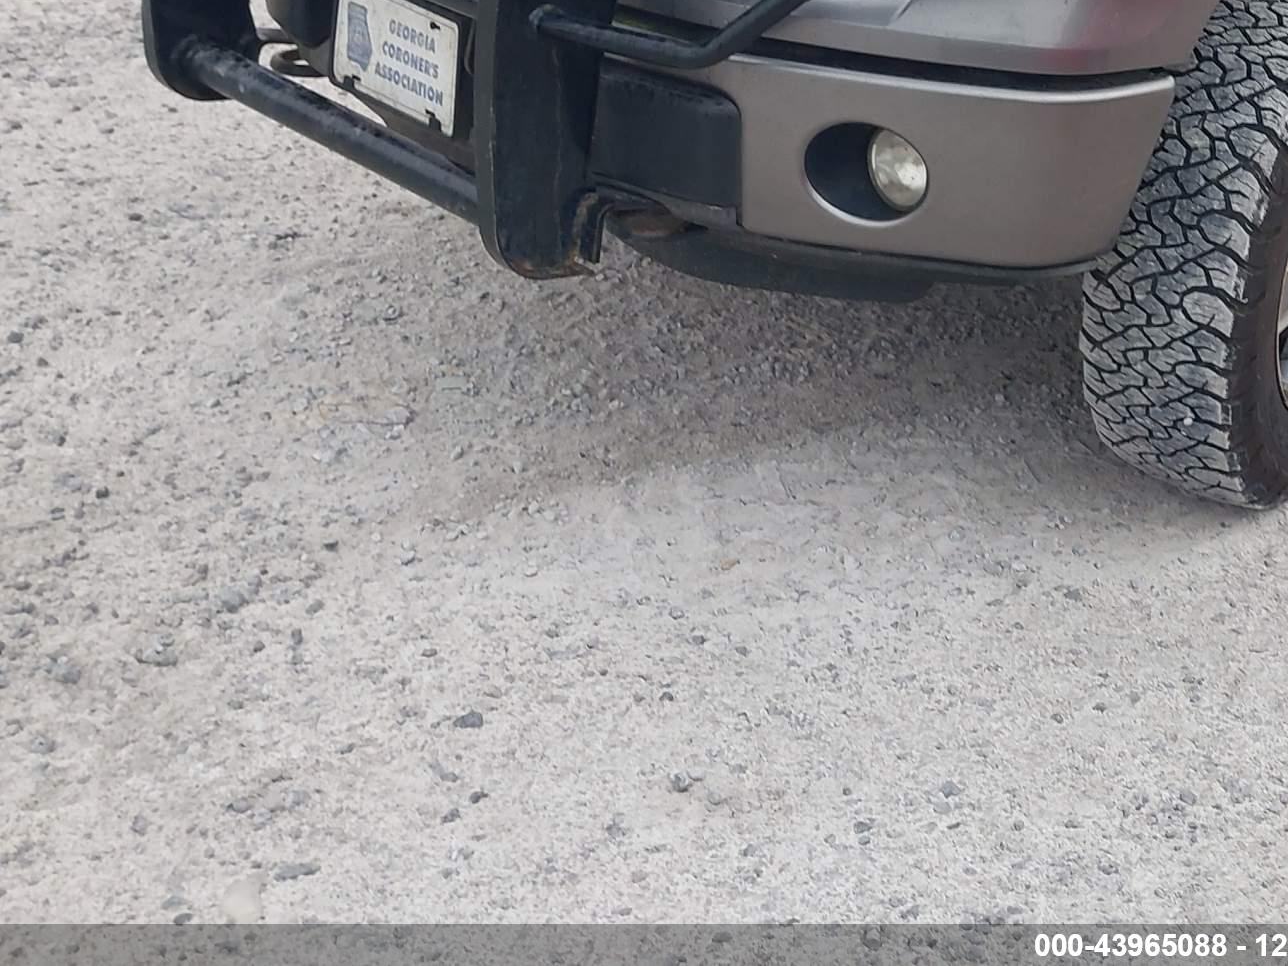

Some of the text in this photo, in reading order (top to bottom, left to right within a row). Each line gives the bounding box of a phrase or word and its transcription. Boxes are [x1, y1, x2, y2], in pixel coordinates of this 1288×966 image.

[388, 18, 436, 54] GEORGIA
[382, 40, 440, 79] CORONER'S
[374, 61, 444, 107] ASSOCIATION
